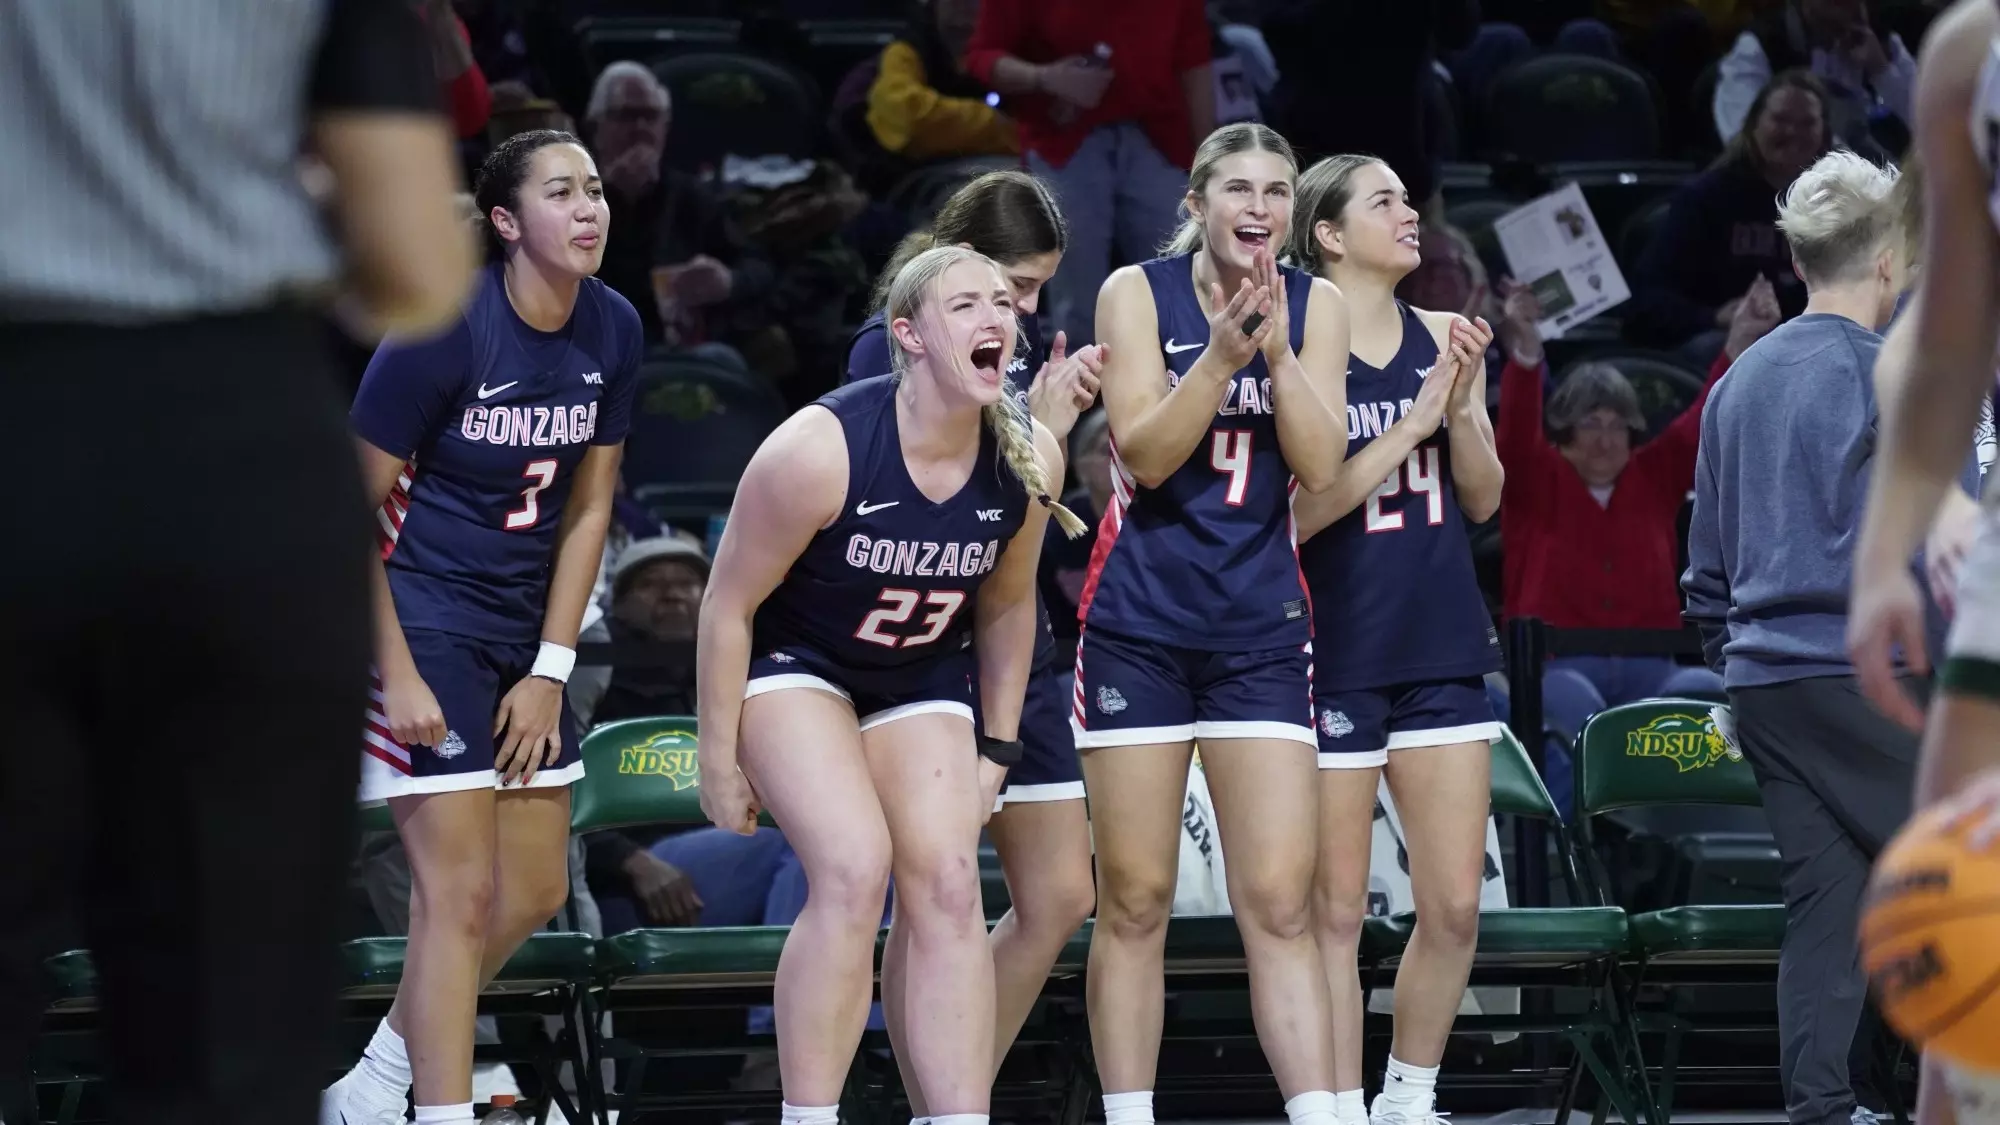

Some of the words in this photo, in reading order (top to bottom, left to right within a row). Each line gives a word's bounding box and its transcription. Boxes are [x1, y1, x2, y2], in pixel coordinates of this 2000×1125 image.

[461, 401, 598, 447] GONZAGA
[1210, 429, 1254, 507] 4
[1364, 445, 1444, 534] 24
[503, 458, 559, 531] 3
[976, 509, 1003, 522] WCC
[846, 534, 999, 577] GONZAGA
[853, 587, 967, 648] 23
[618, 748, 699, 777] NDSU
[1626, 731, 1704, 758] NDSU
